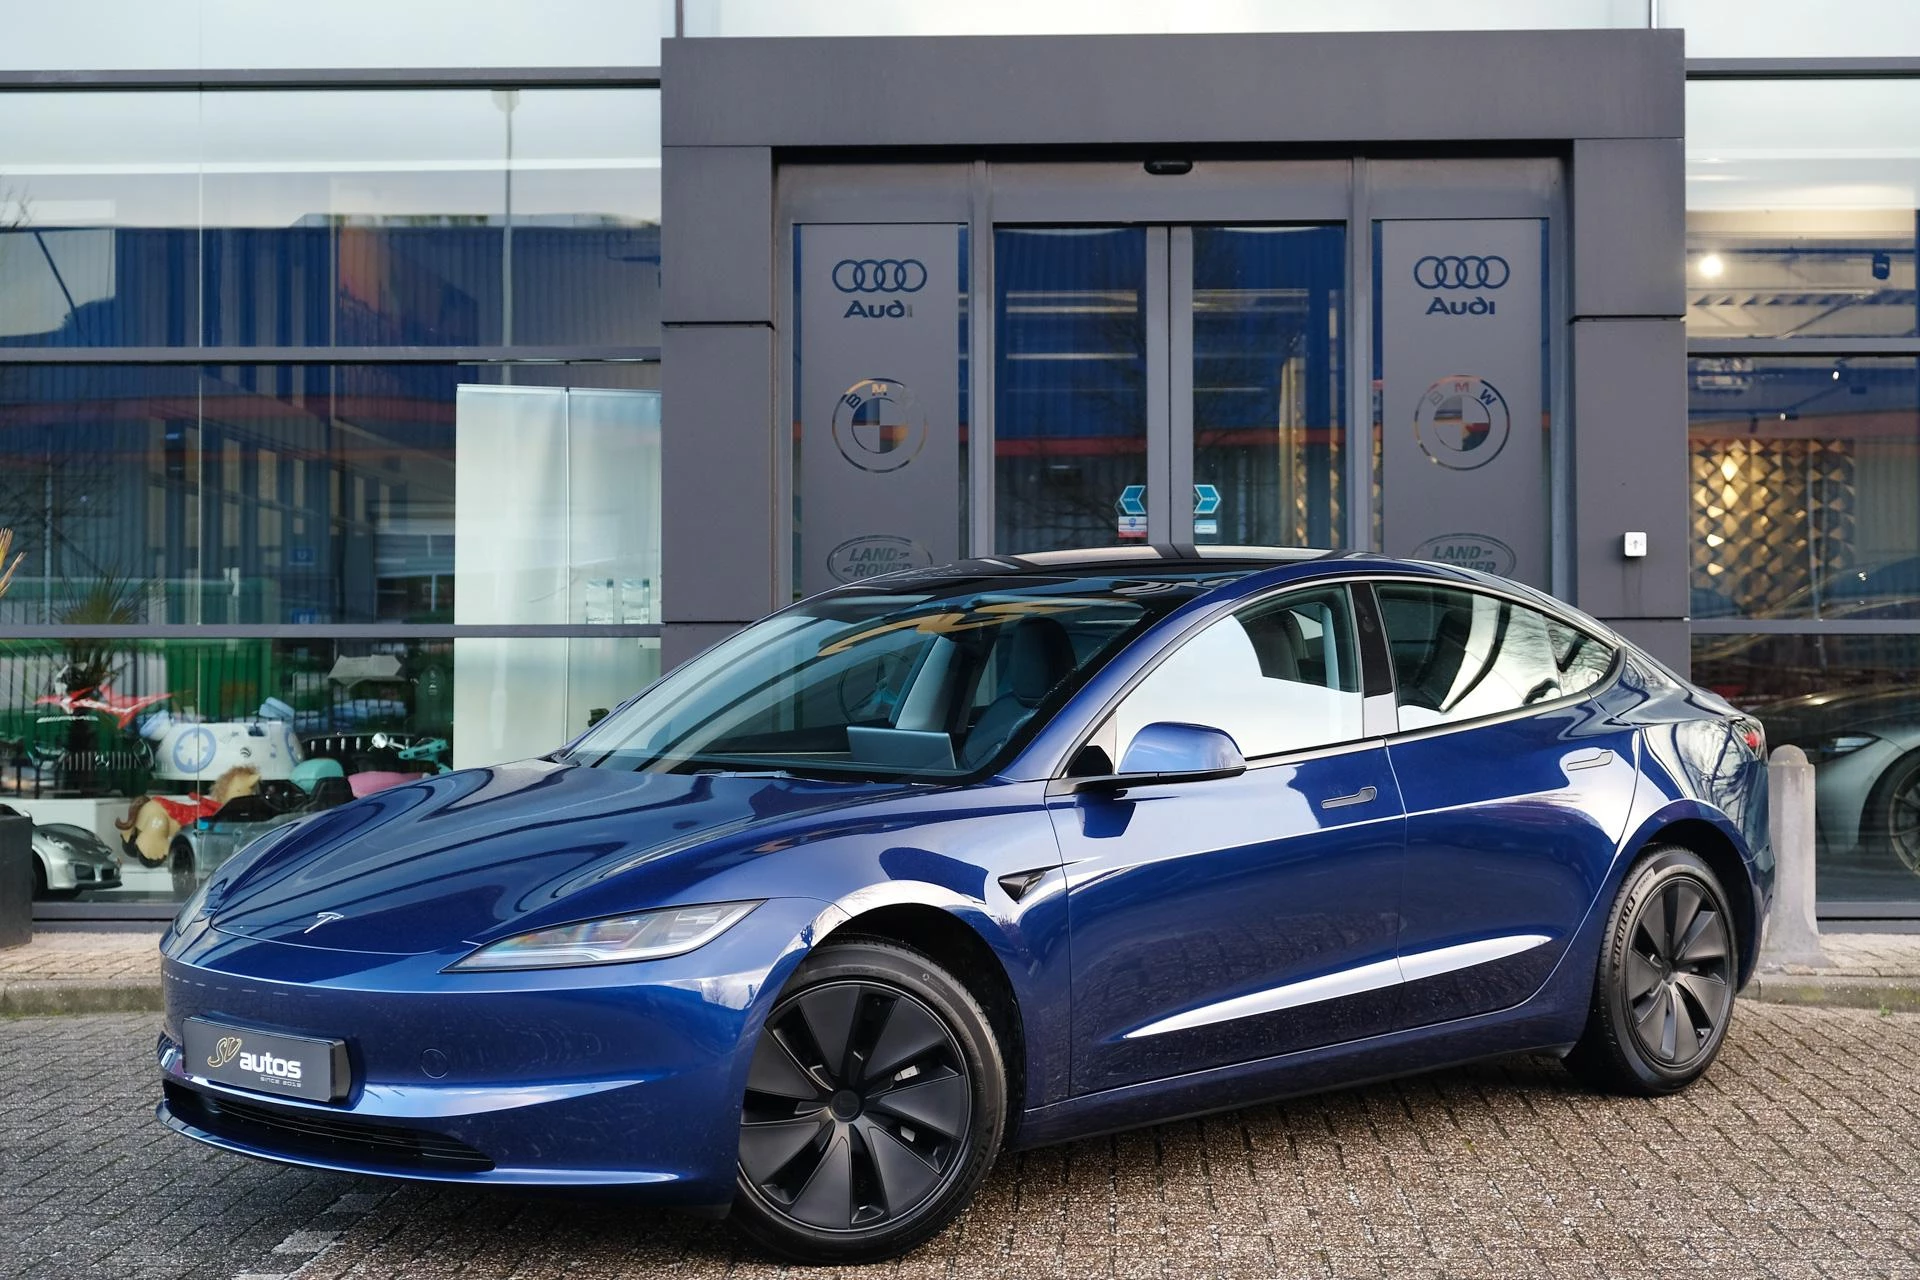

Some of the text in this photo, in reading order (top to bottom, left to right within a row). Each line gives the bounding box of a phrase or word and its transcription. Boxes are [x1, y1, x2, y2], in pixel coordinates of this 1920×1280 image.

[843, 300, 913, 318] Audi
[1425, 296, 1495, 315] Audi
[849, 547, 898, 561] LAND
[1432, 546, 1482, 560] LAND
[207, 1037, 301, 1079] SV autos
